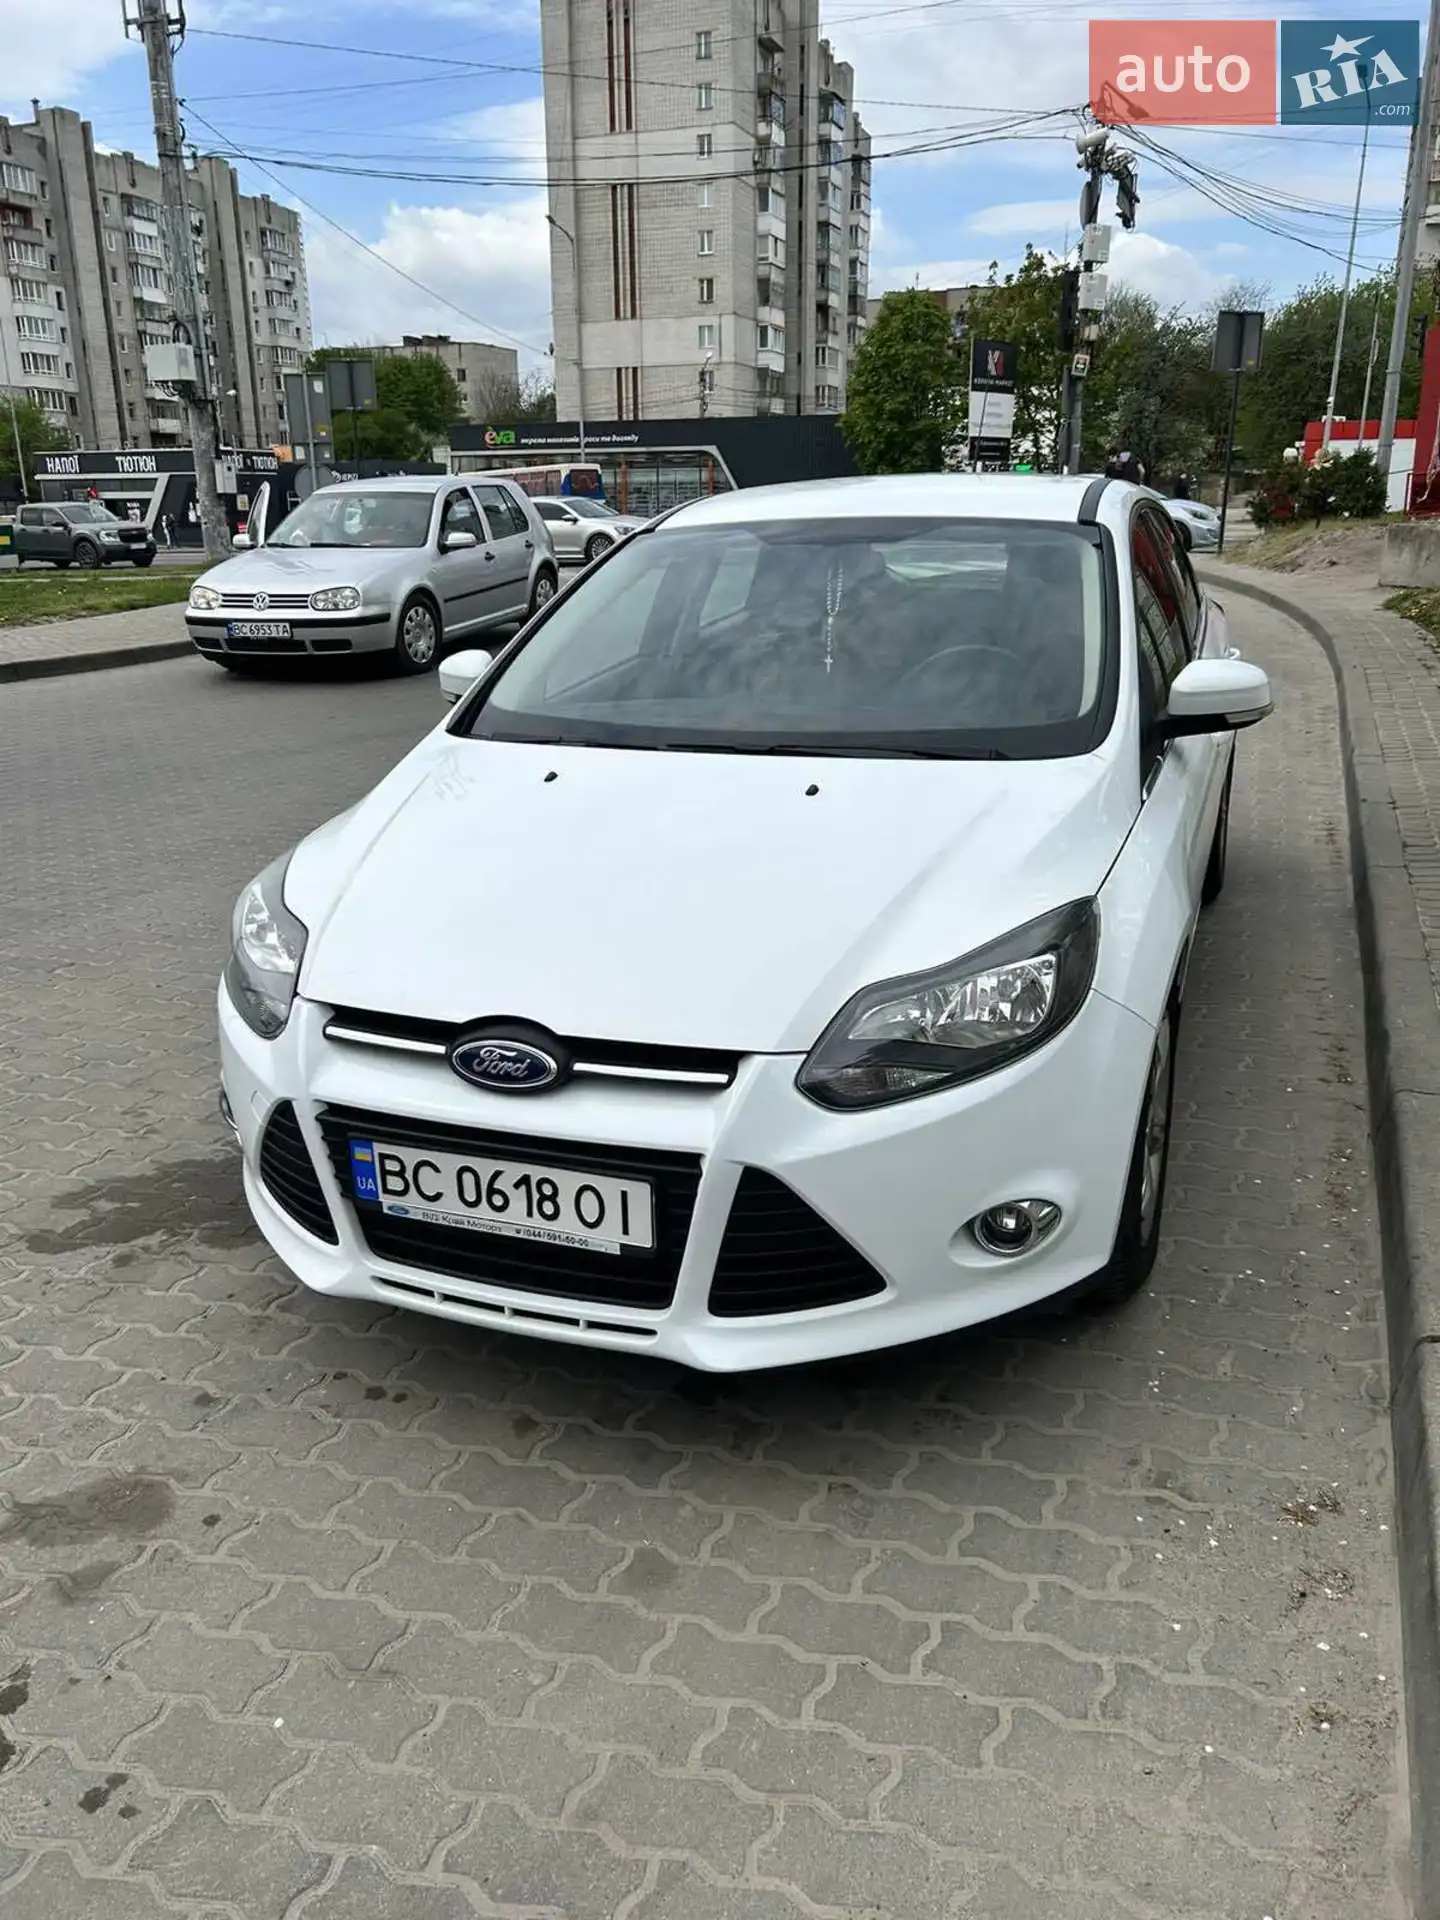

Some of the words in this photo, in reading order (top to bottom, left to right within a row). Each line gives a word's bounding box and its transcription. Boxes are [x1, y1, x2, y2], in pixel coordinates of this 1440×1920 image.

[45, 455, 80, 473] НАПОЇ
[115, 455, 157, 473] ТЮТЮН
[233, 624, 248, 635] BC
[249, 623, 273, 636] 6953
[273, 624, 290, 635] TA
[472, 1046, 531, 1078] Ford
[356, 1175, 376, 1192] UA
[377, 1151, 444, 1203] BC
[456, 1164, 561, 1222] 0618
